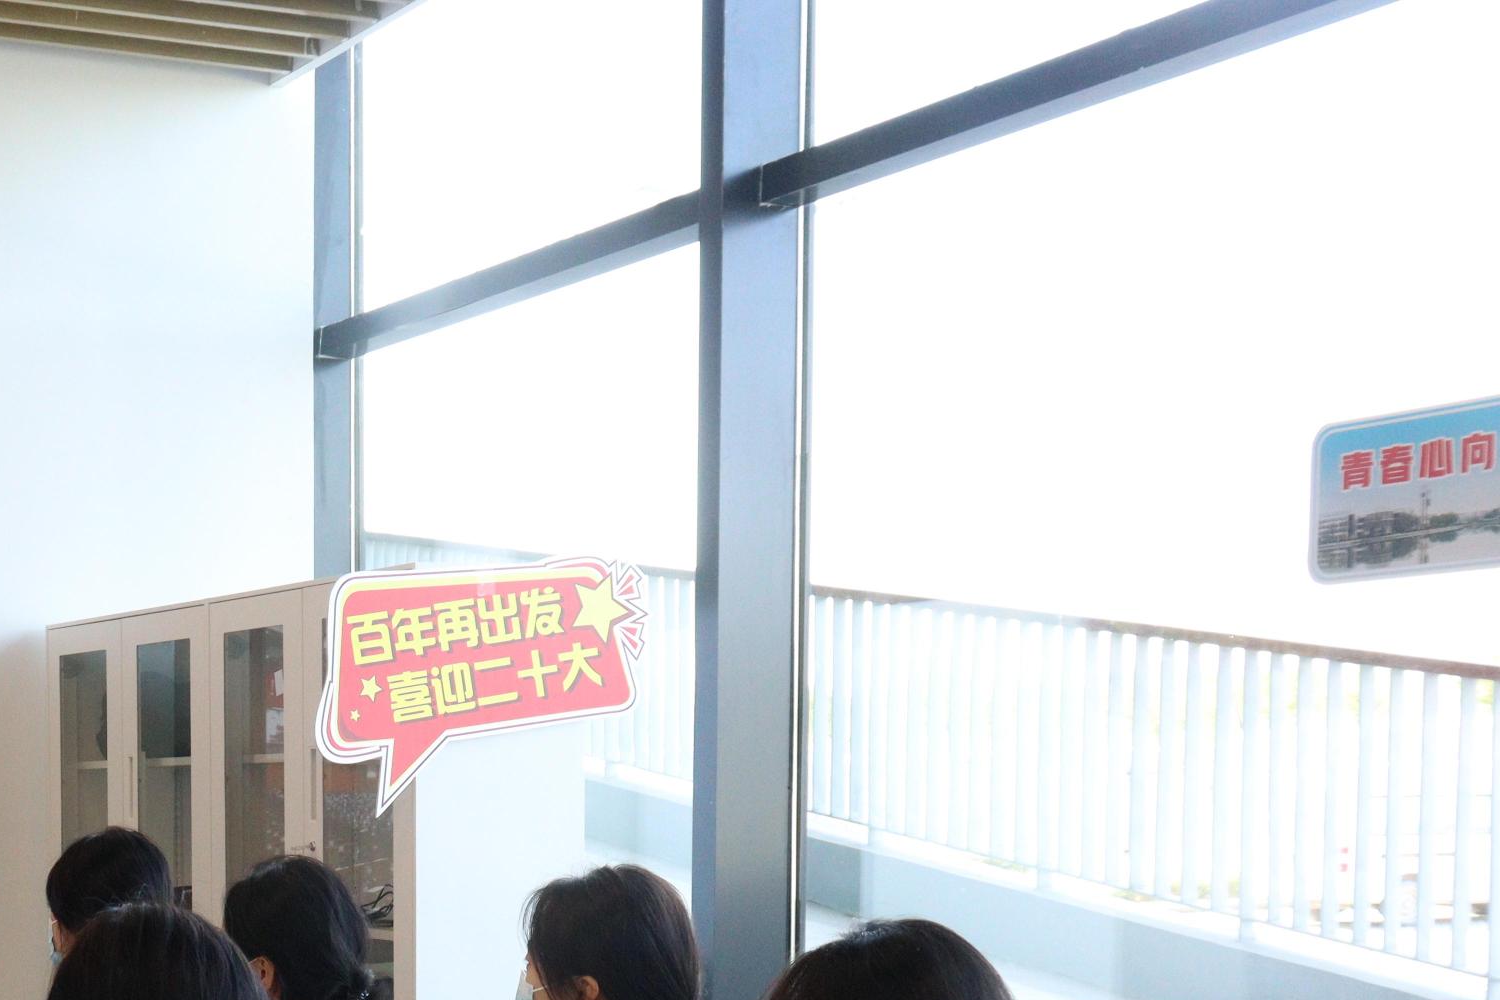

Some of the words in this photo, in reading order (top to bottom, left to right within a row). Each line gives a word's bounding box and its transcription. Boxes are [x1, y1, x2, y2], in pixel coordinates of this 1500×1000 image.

[1341, 432, 1497, 491] 青春心向
[346, 587, 565, 666] 百年再出发
[387, 642, 603, 723] 喜迎二十大
